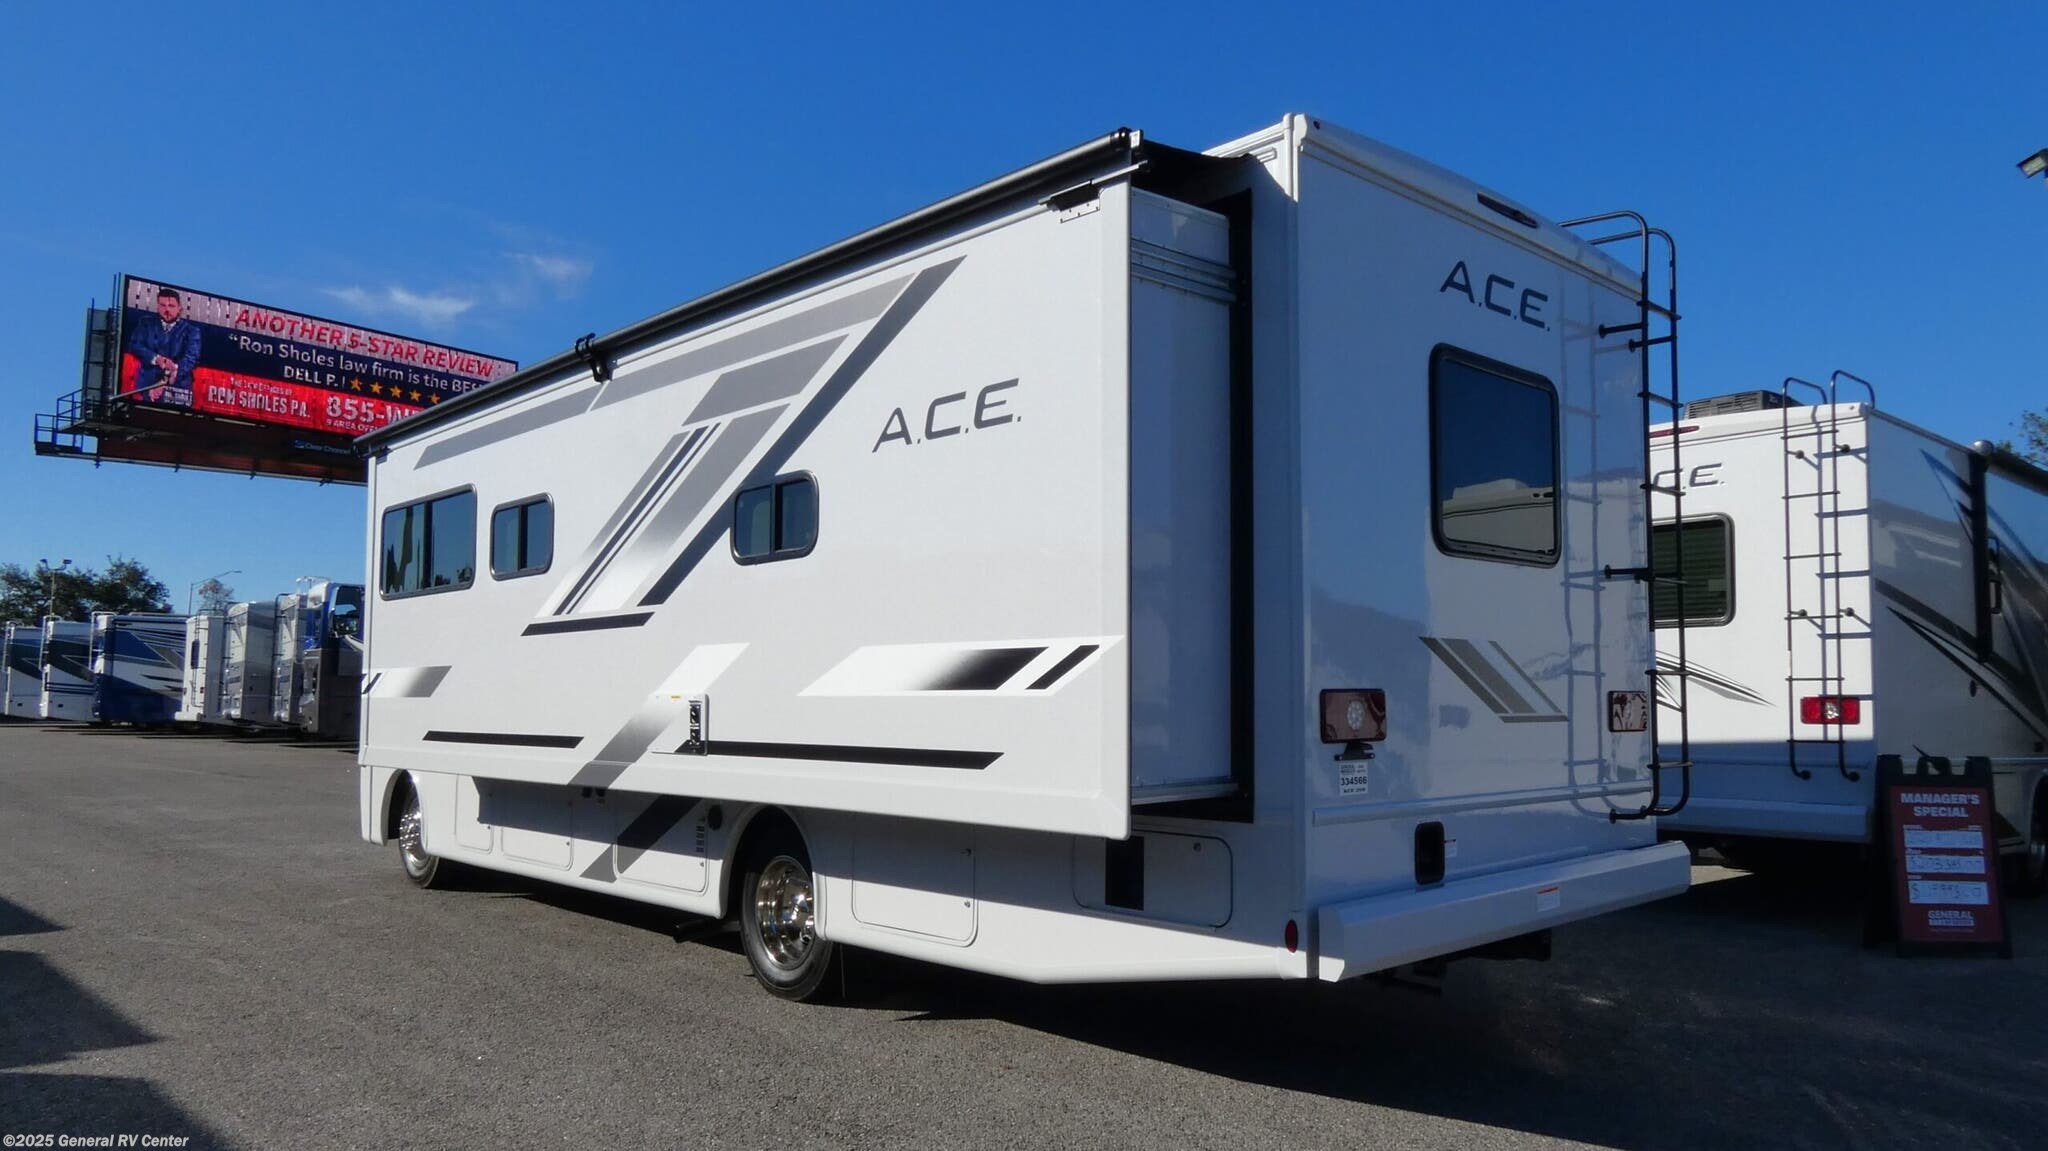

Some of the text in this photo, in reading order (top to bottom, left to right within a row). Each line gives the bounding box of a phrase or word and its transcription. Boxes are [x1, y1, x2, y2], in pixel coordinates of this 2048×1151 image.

[1439, 260, 1551, 332] A.C.E.
[235, 308, 493, 378] ANOTHER 5-STAR REVIEW
[278, 344, 334, 367] Sholes
[339, 355, 368, 374] law
[372, 361, 404, 381] firm
[408, 369, 420, 384] is
[423, 374, 448, 391] the
[452, 379, 482, 394] BES
[283, 365, 339, 387] DELL P.
[208, 385, 236, 405] RON
[239, 391, 288, 414] SHOLES
[290, 399, 311, 418] P.A.
[326, 395, 420, 425] 855-W
[872, 378, 1022, 453] A.C.E.
[333, 419, 357, 431] AREA
[1900, 792, 1980, 805] MANAGER'S
[1913, 806, 1969, 818] SPECIAL
[1928, 910, 1974, 919] GENERAL
